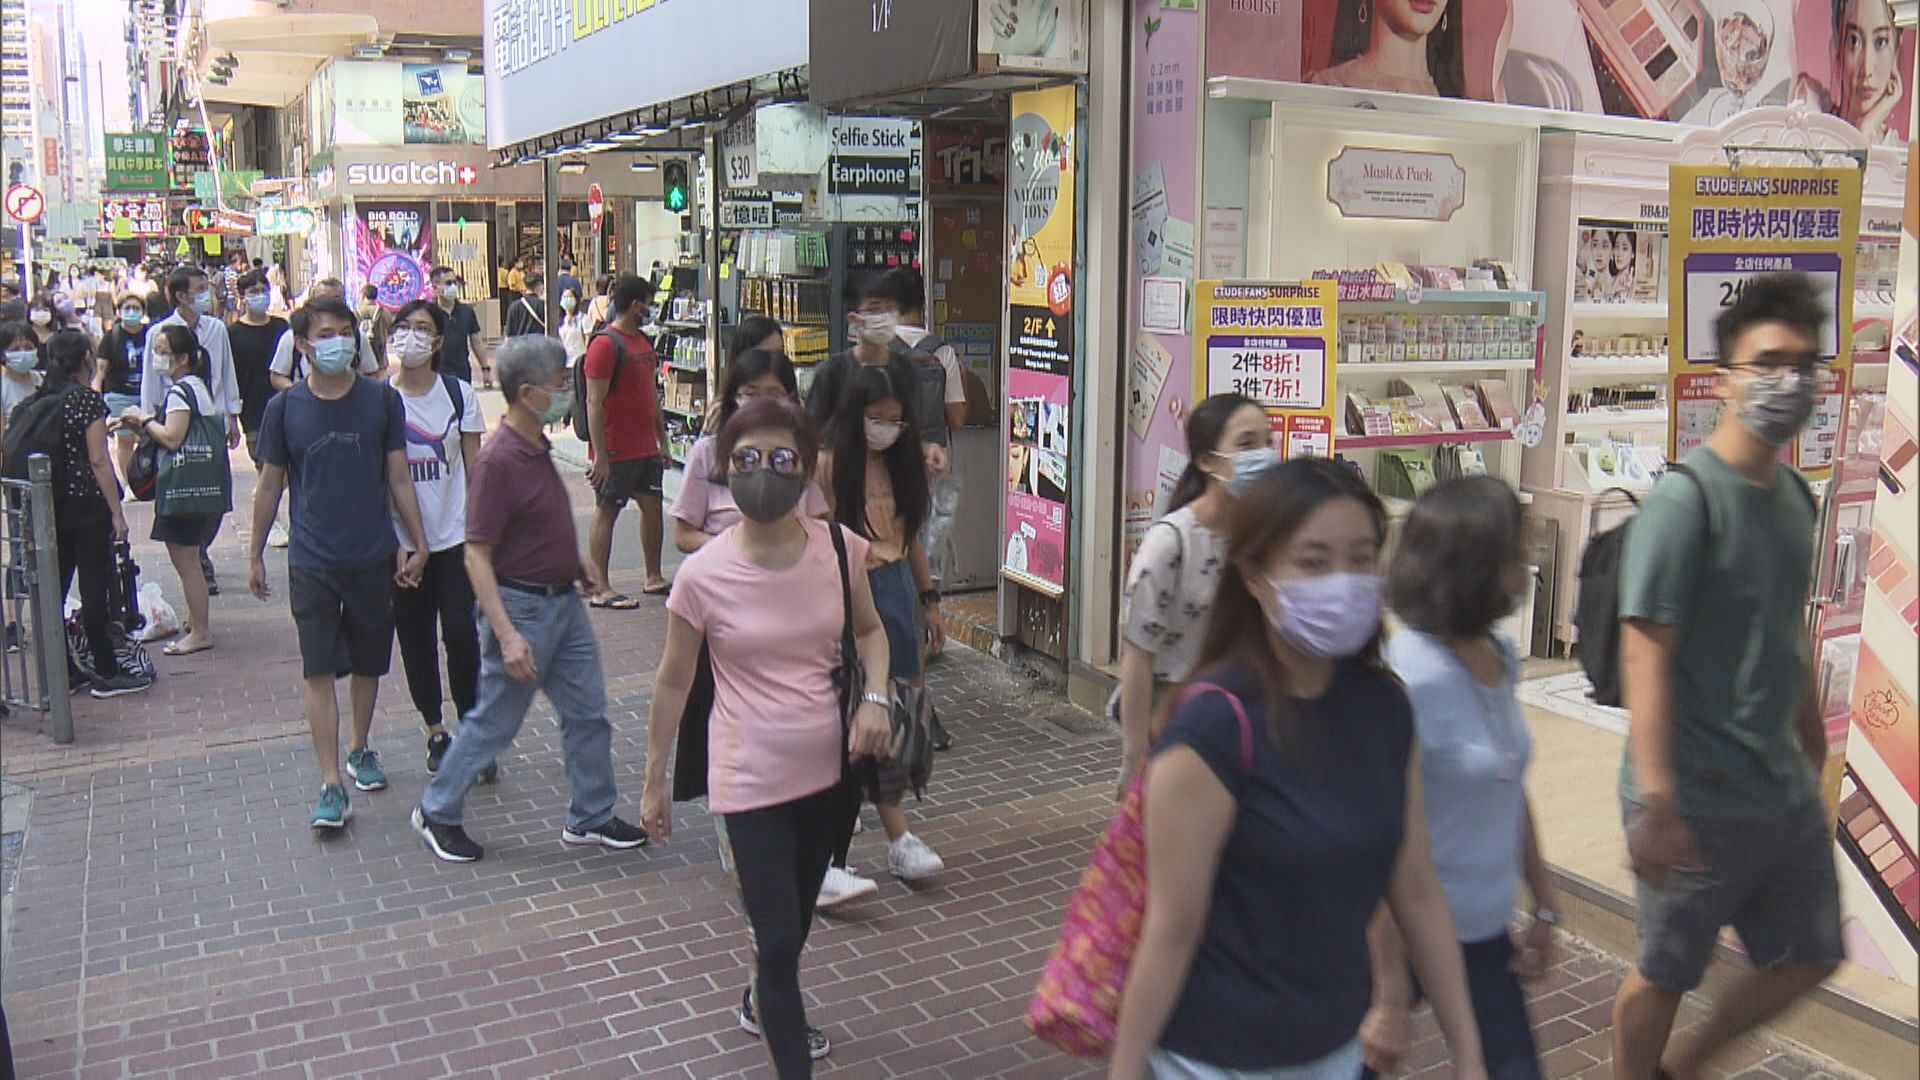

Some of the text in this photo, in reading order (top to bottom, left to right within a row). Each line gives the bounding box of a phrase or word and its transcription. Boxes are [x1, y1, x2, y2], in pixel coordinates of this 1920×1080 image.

[1230, 0, 1280, 15] HOUSE
[832, 128, 905, 148] Selfie Stick
[347, 160, 456, 185] swatch
[731, 154, 750, 182] $30
[831, 162, 905, 189] Earphone
[1363, 163, 1433, 183] Mask & Pack
[1695, 176, 1839, 196] ETUDE FANS SURPRISE
[367, 210, 419, 221] BIG BOLD
[1024, 204, 1049, 219] TOYS
[1691, 207, 1841, 240] 限時快閃優惠
[1214, 285, 1320, 300] ETUDE FANS SURPRISE
[1023, 316, 1043, 336] 2/F
[1211, 306, 1323, 328] 限時快閃優惠
[1231, 351, 1301, 374] 2件8折!
[1231, 376, 1301, 399] 3件7折!
